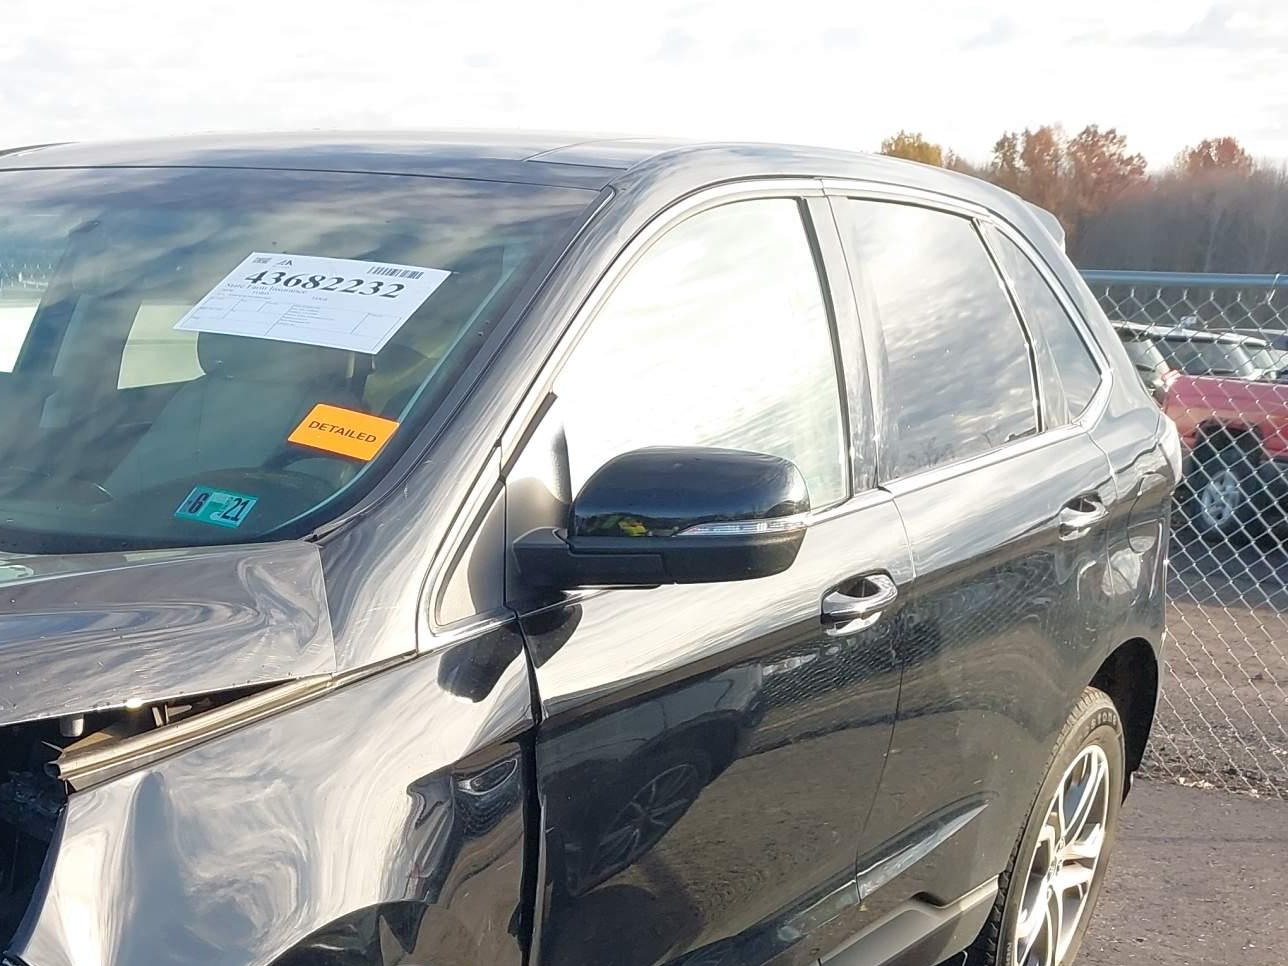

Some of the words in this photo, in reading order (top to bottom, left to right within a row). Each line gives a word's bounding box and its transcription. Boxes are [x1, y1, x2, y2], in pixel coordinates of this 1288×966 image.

[245, 270, 405, 298] 43682232
[308, 420, 377, 443] DETAILED
[188, 492, 210, 514] 6
[221, 497, 250, 521] 21
